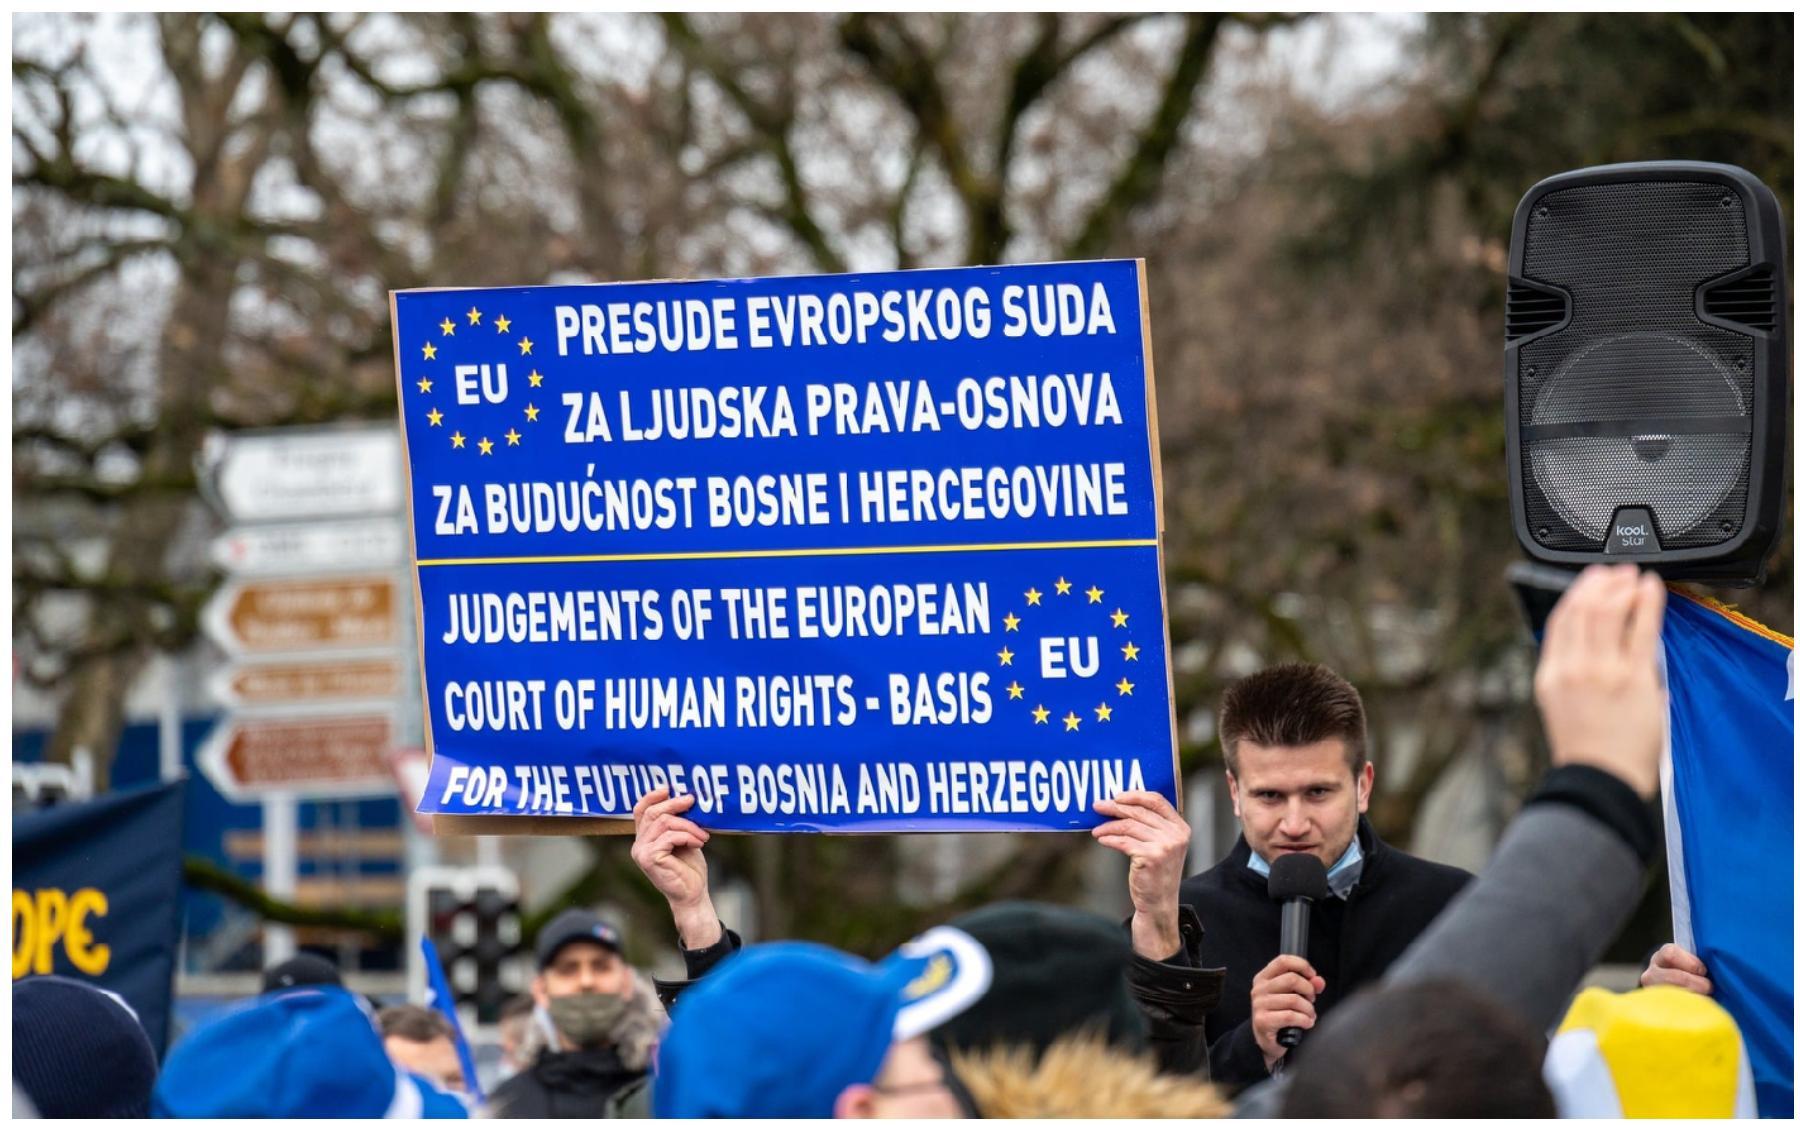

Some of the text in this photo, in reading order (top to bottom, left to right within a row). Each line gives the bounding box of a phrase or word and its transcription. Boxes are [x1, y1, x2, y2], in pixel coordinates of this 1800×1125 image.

[555, 282, 1117, 356] PRESUDE EVROPSKOG SUDA
[455, 363, 509, 405] EU
[562, 372, 1124, 443] ZA LJUDSKA PRAVA-OSNOVA
[432, 463, 1129, 536] ZA BUDUĆNOST BOSNE I HERCEGOVINE
[442, 589, 664, 644] JUDGEMENTS
[671, 588, 713, 640] OF
[720, 587, 790, 639] THE
[796, 582, 991, 638] EUROPEAN
[1040, 637, 1101, 679] EU
[444, 680, 546, 731] COURT
[554, 679, 596, 730] OF
[605, 676, 726, 729] HUMAN
[735, 674, 857, 728] RIGHTS
[888, 671, 994, 726] BASIS
[441, 765, 509, 807] FOR
[514, 765, 575, 813] THE
[692, 764, 730, 814] OF
[736, 763, 851, 814] BOSNIA
[857, 762, 921, 814] AND
[926, 759, 1147, 813] HERZEGOVINA
